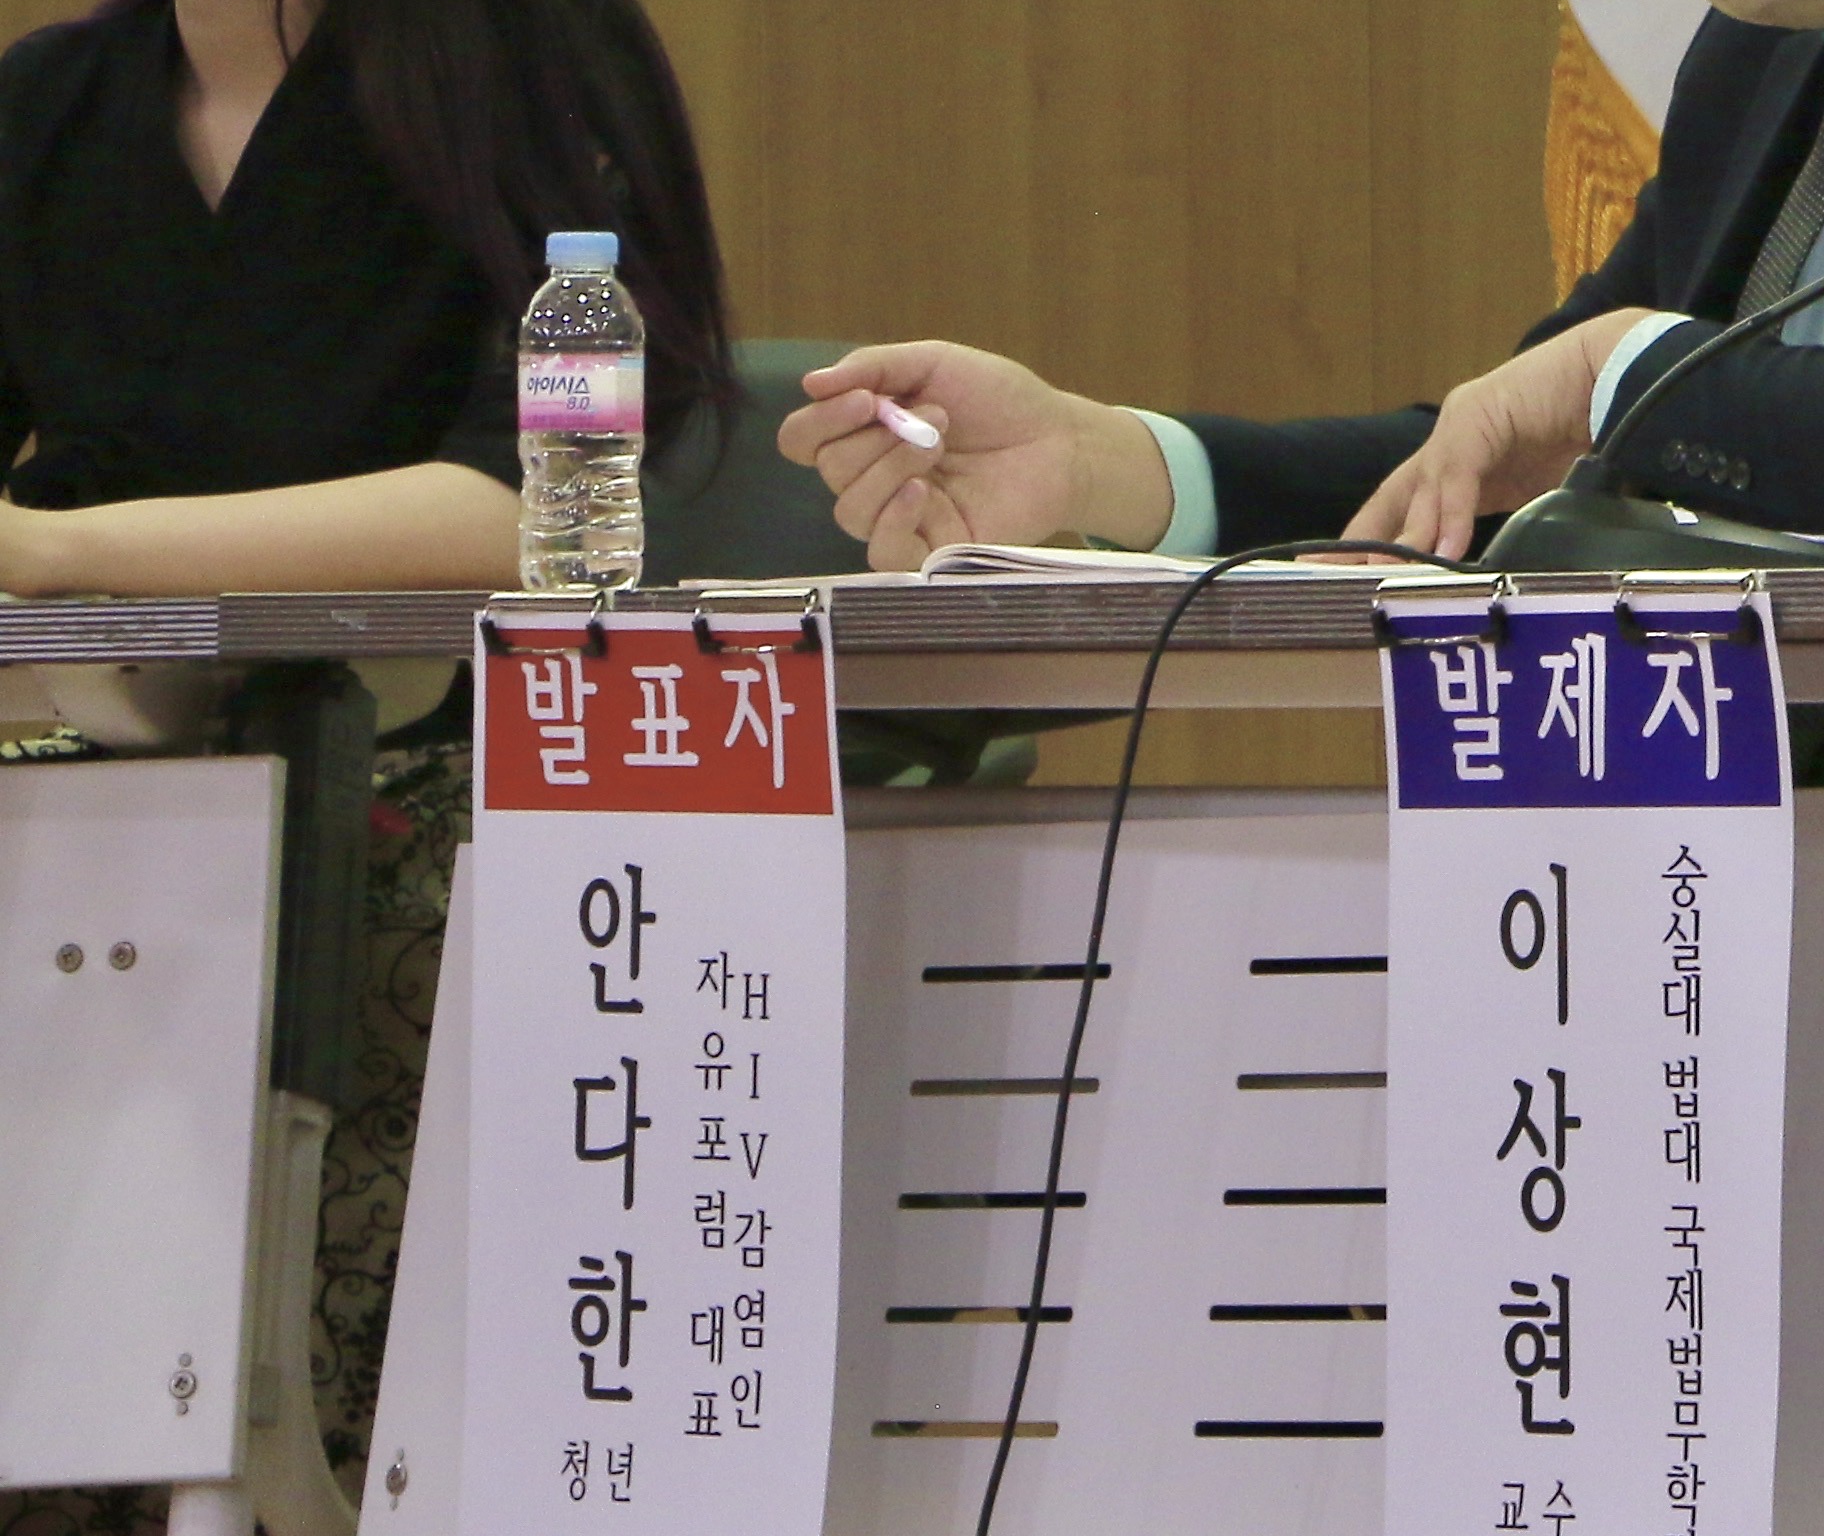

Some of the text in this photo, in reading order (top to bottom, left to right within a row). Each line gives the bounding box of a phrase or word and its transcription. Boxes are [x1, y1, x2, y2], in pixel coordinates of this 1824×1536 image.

[527, 376, 591, 395] 아이시스
[520, 651, 796, 790] 발표자
[1428, 632, 1733, 782] 발제자
[567, 862, 657, 1403] 안다한
[1495, 861, 1583, 1436] 이상현
[1660, 843, 1709, 1536] 숭실대 법대 국제법무학
[683, 1304, 725, 1438] 대표
[560, 1439, 635, 1504] 청년
[1494, 1479, 1577, 1536] 교수
